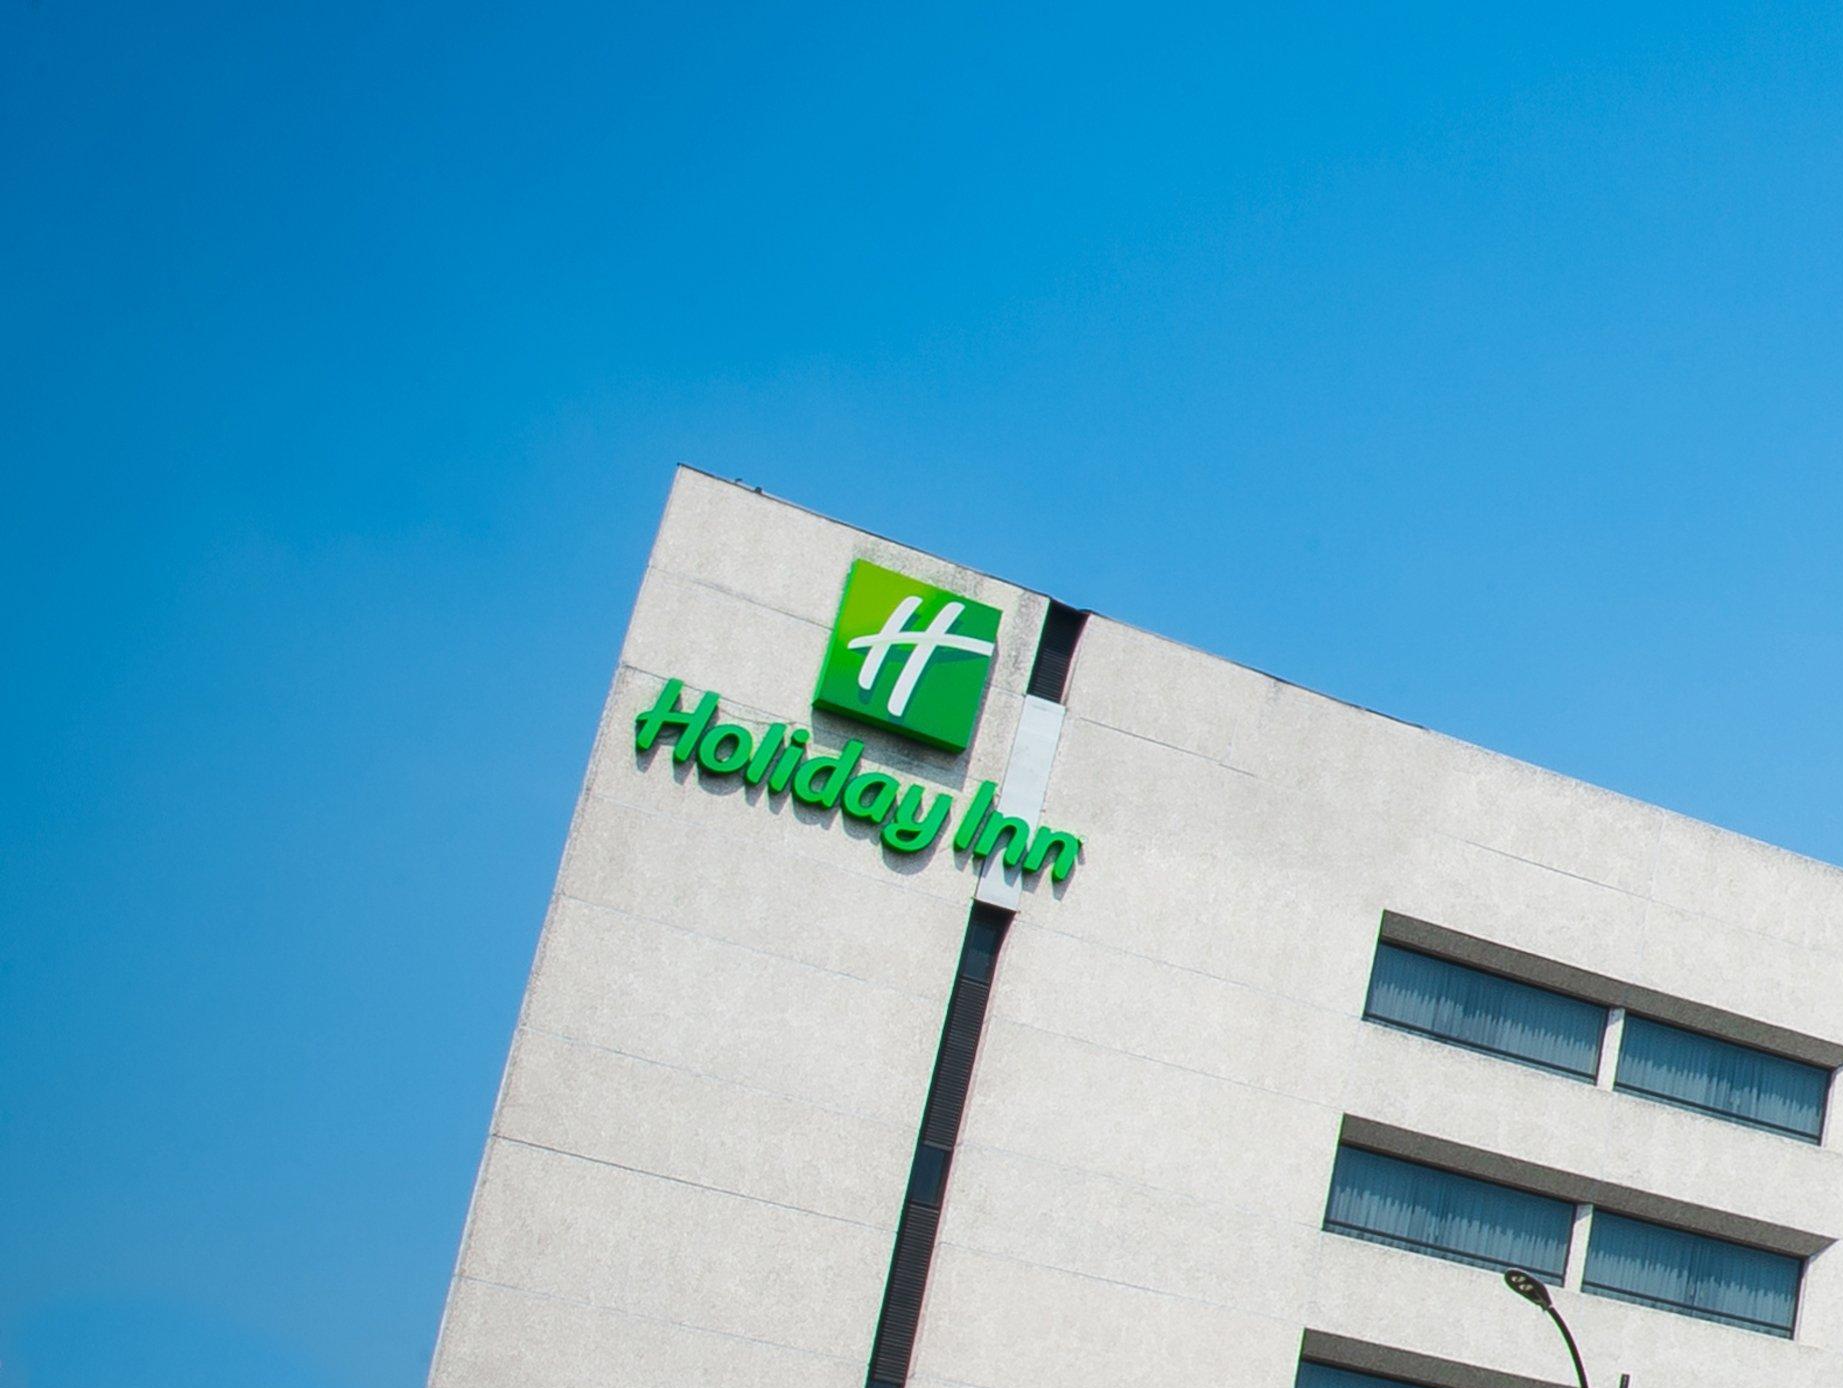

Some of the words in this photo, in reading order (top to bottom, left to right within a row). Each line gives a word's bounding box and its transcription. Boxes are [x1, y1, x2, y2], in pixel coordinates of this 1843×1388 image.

[848, 596, 994, 717] H
[636, 677, 954, 853] Holiday
[954, 780, 1081, 882] Inn
